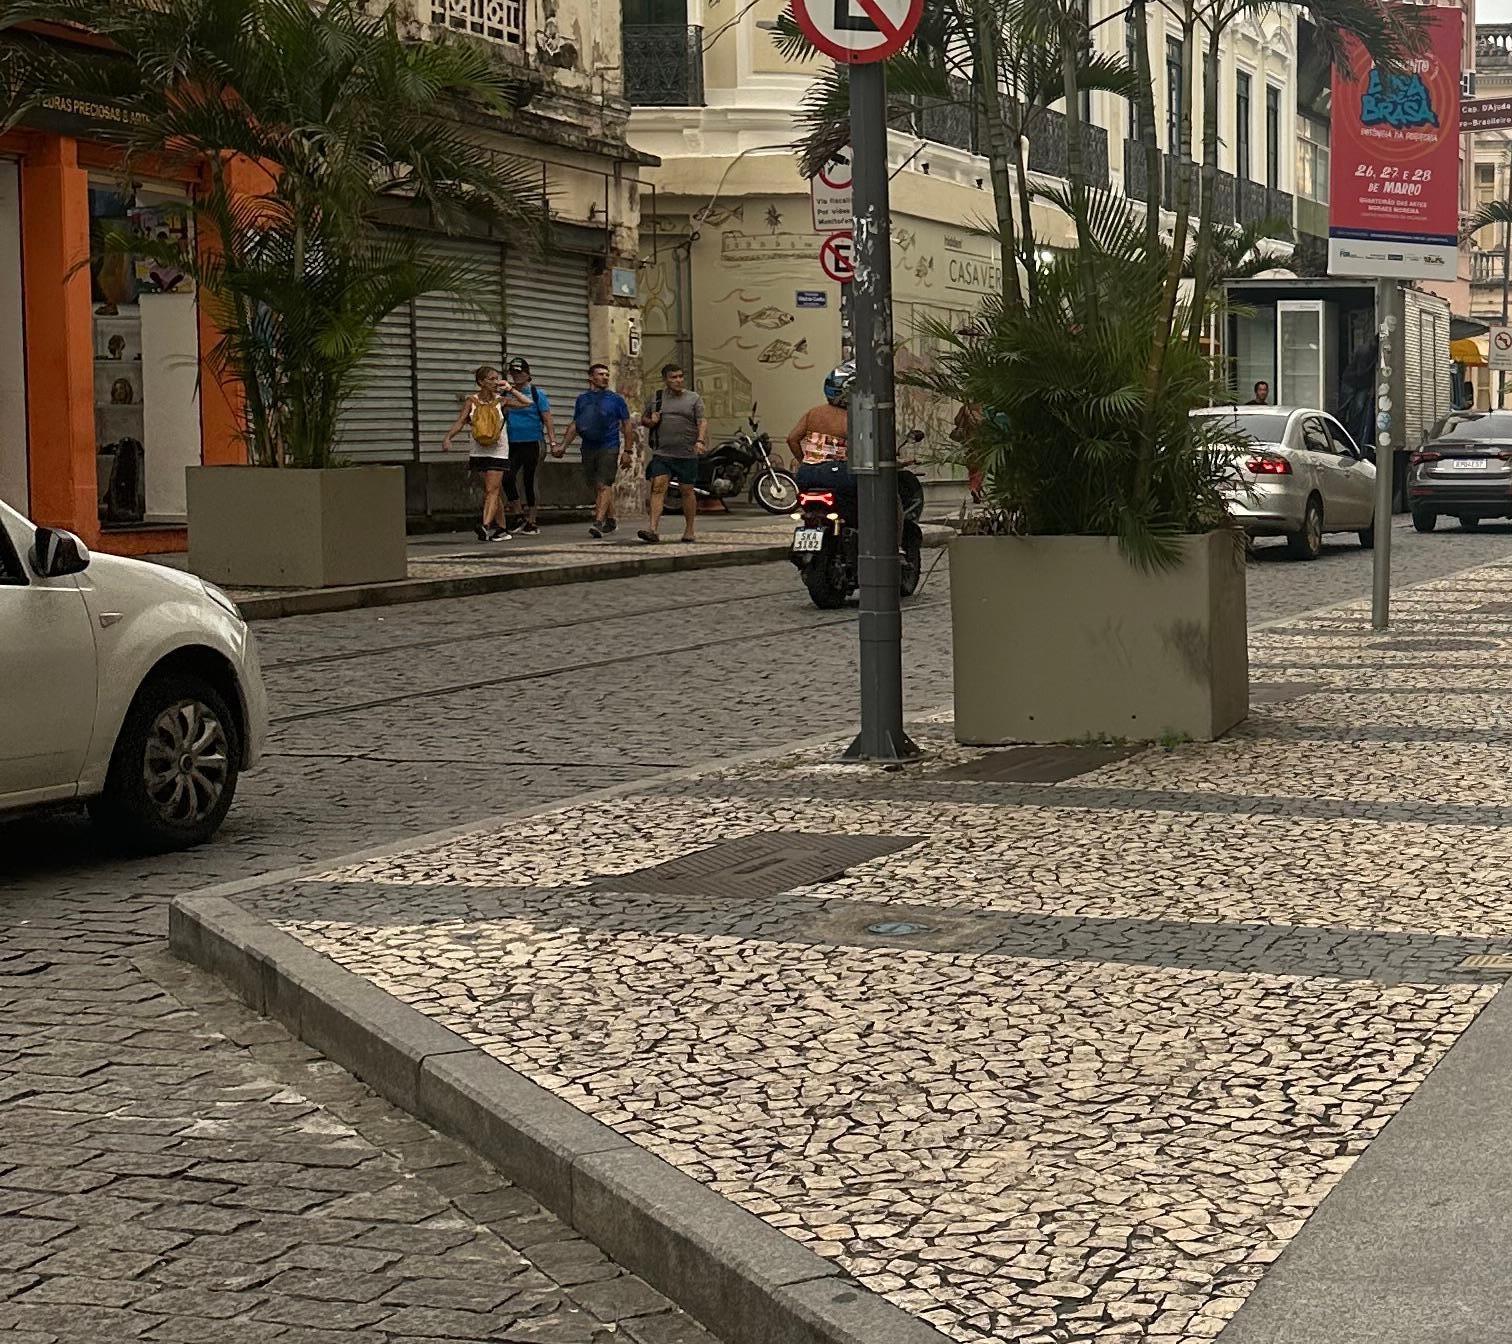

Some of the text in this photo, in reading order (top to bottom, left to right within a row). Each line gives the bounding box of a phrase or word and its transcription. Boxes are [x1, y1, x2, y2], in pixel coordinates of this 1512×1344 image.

[73, 99, 121, 123] PRECIOSAS
[1459, 117, 1512, 128] ro-Brasileiro
[1379, 166, 1399, 179] 27
[1402, 170, 1410, 180] E
[1411, 169, 1432, 182] 28
[1367, 181, 1422, 196] DE MARÇO
[834, 244, 851, 273] E
